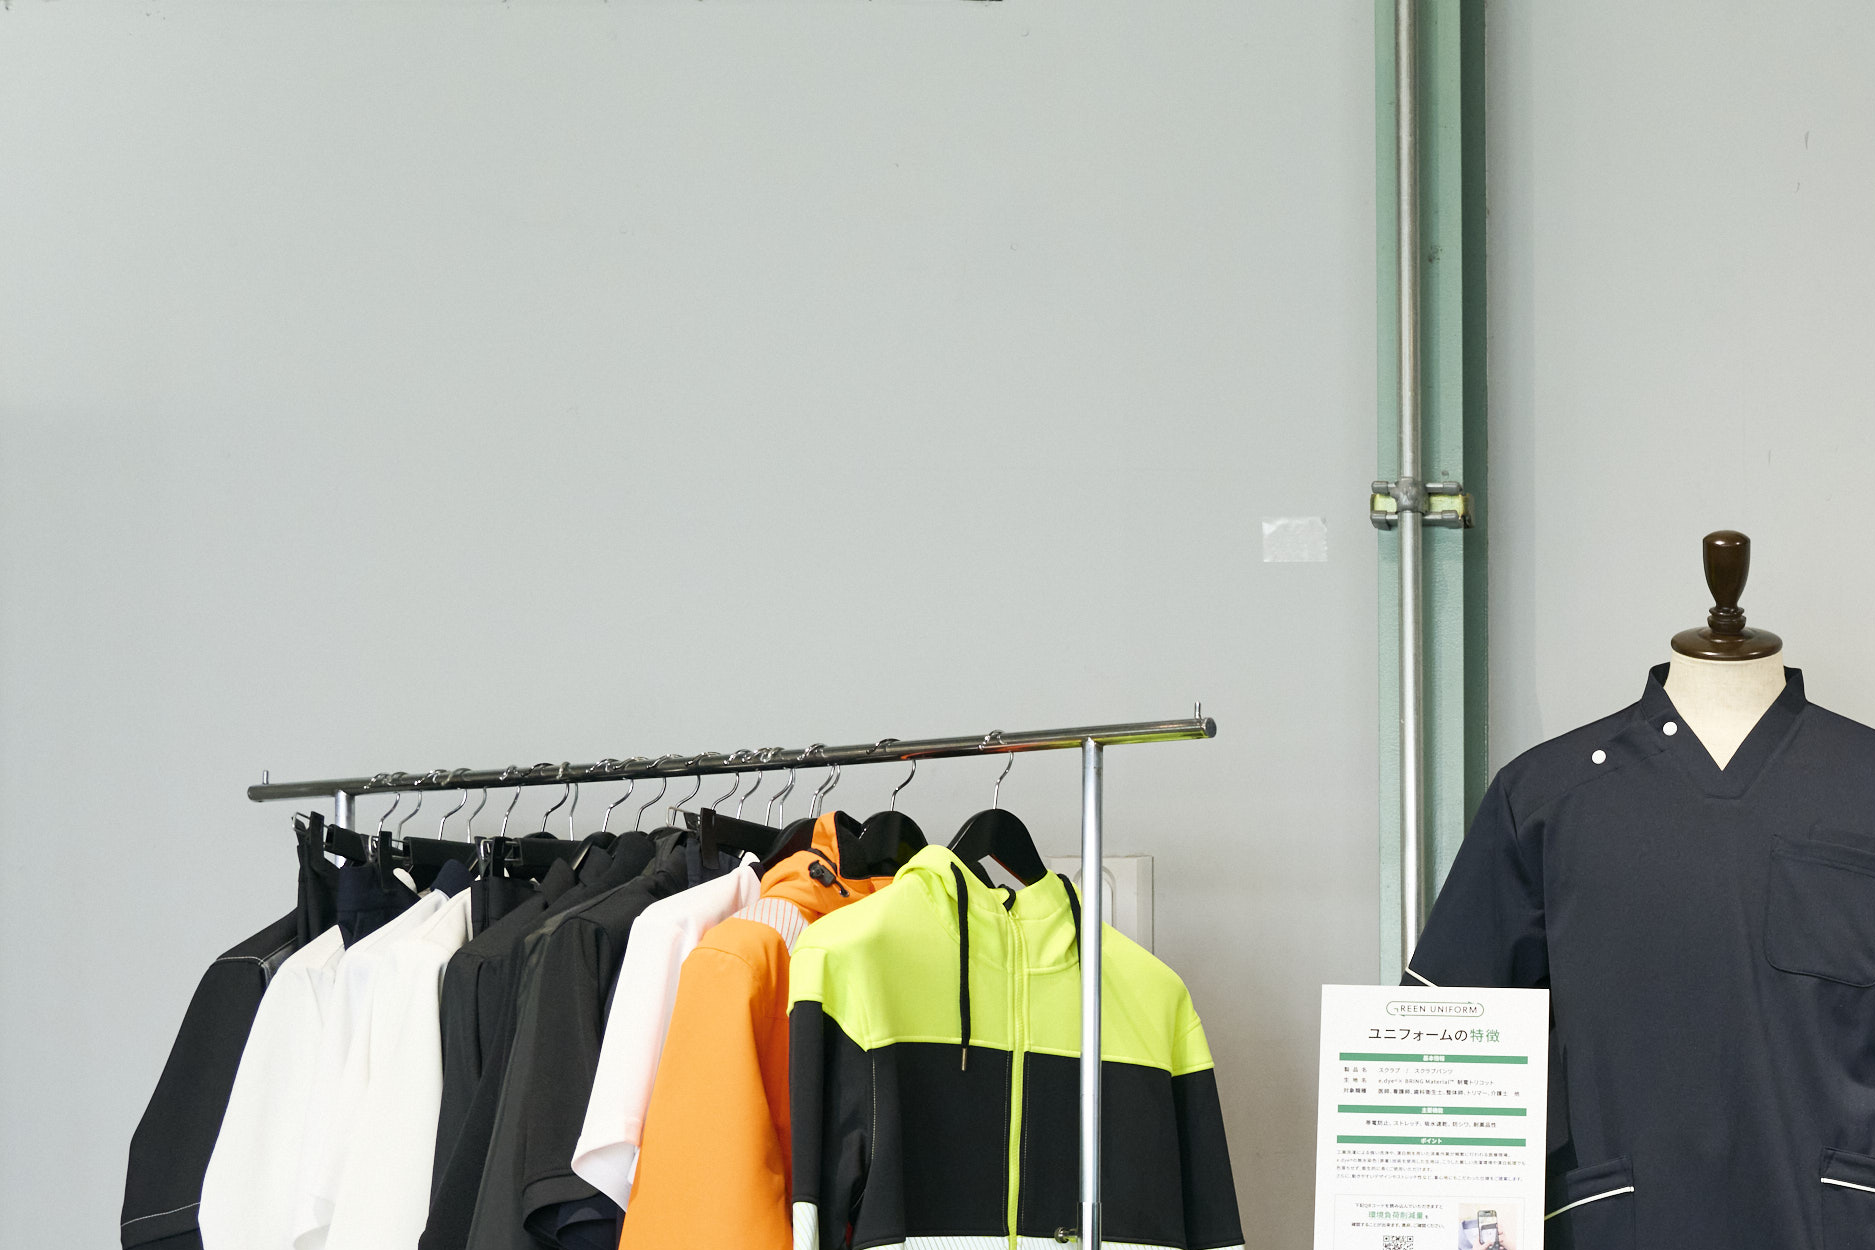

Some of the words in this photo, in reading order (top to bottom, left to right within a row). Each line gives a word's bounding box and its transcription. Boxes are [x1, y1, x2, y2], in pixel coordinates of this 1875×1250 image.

[1430, 1004, 1478, 1014] UNIFORM
[1368, 1028, 1500, 1043] ユニフォームの特徴
